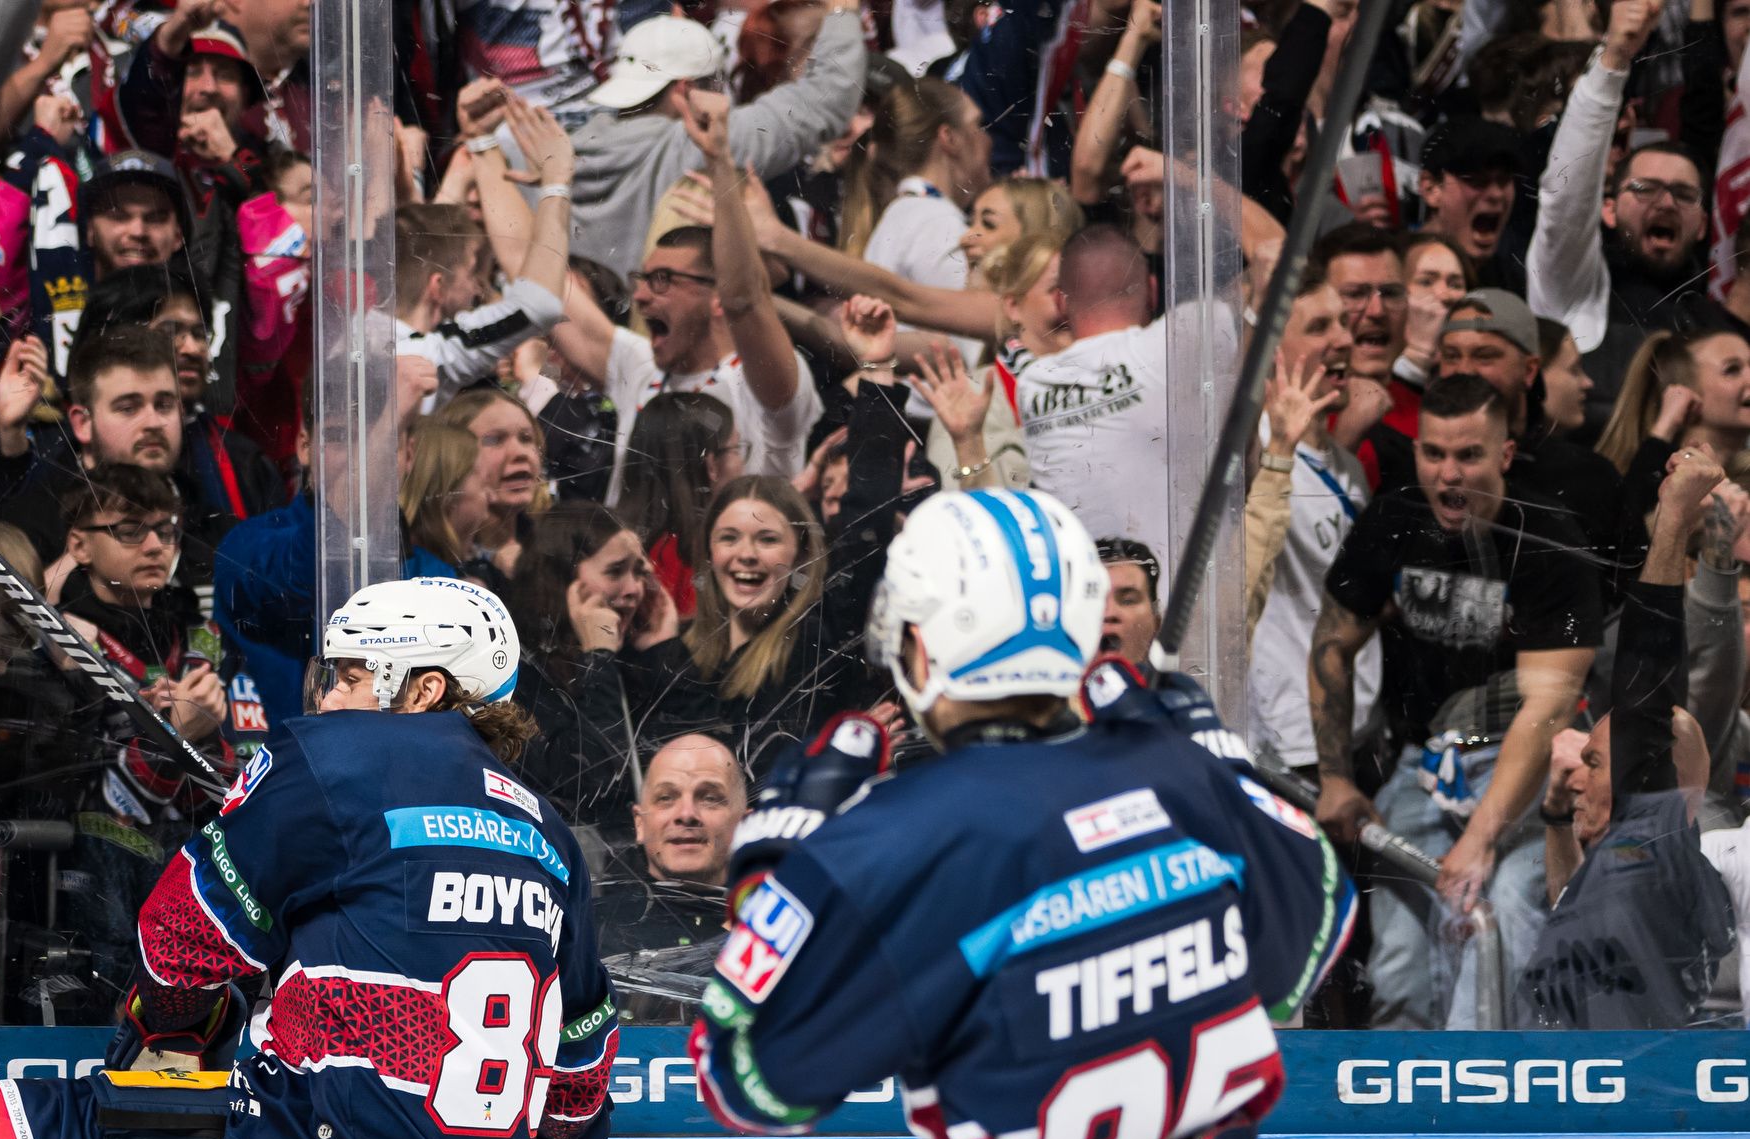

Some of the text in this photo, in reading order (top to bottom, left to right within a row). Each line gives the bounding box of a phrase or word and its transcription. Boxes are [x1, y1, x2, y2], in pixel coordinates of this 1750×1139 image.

[419, 579, 507, 621] STADLER
[359, 636, 418, 646] STADLER
[213, 844, 236, 883] LIGO
[236, 884, 261, 921] LIGO
[1035, 903, 1249, 1041] TIFFELS
[566, 1011, 603, 1040] LIGO
[1336, 1058, 1627, 1104] GASAG
